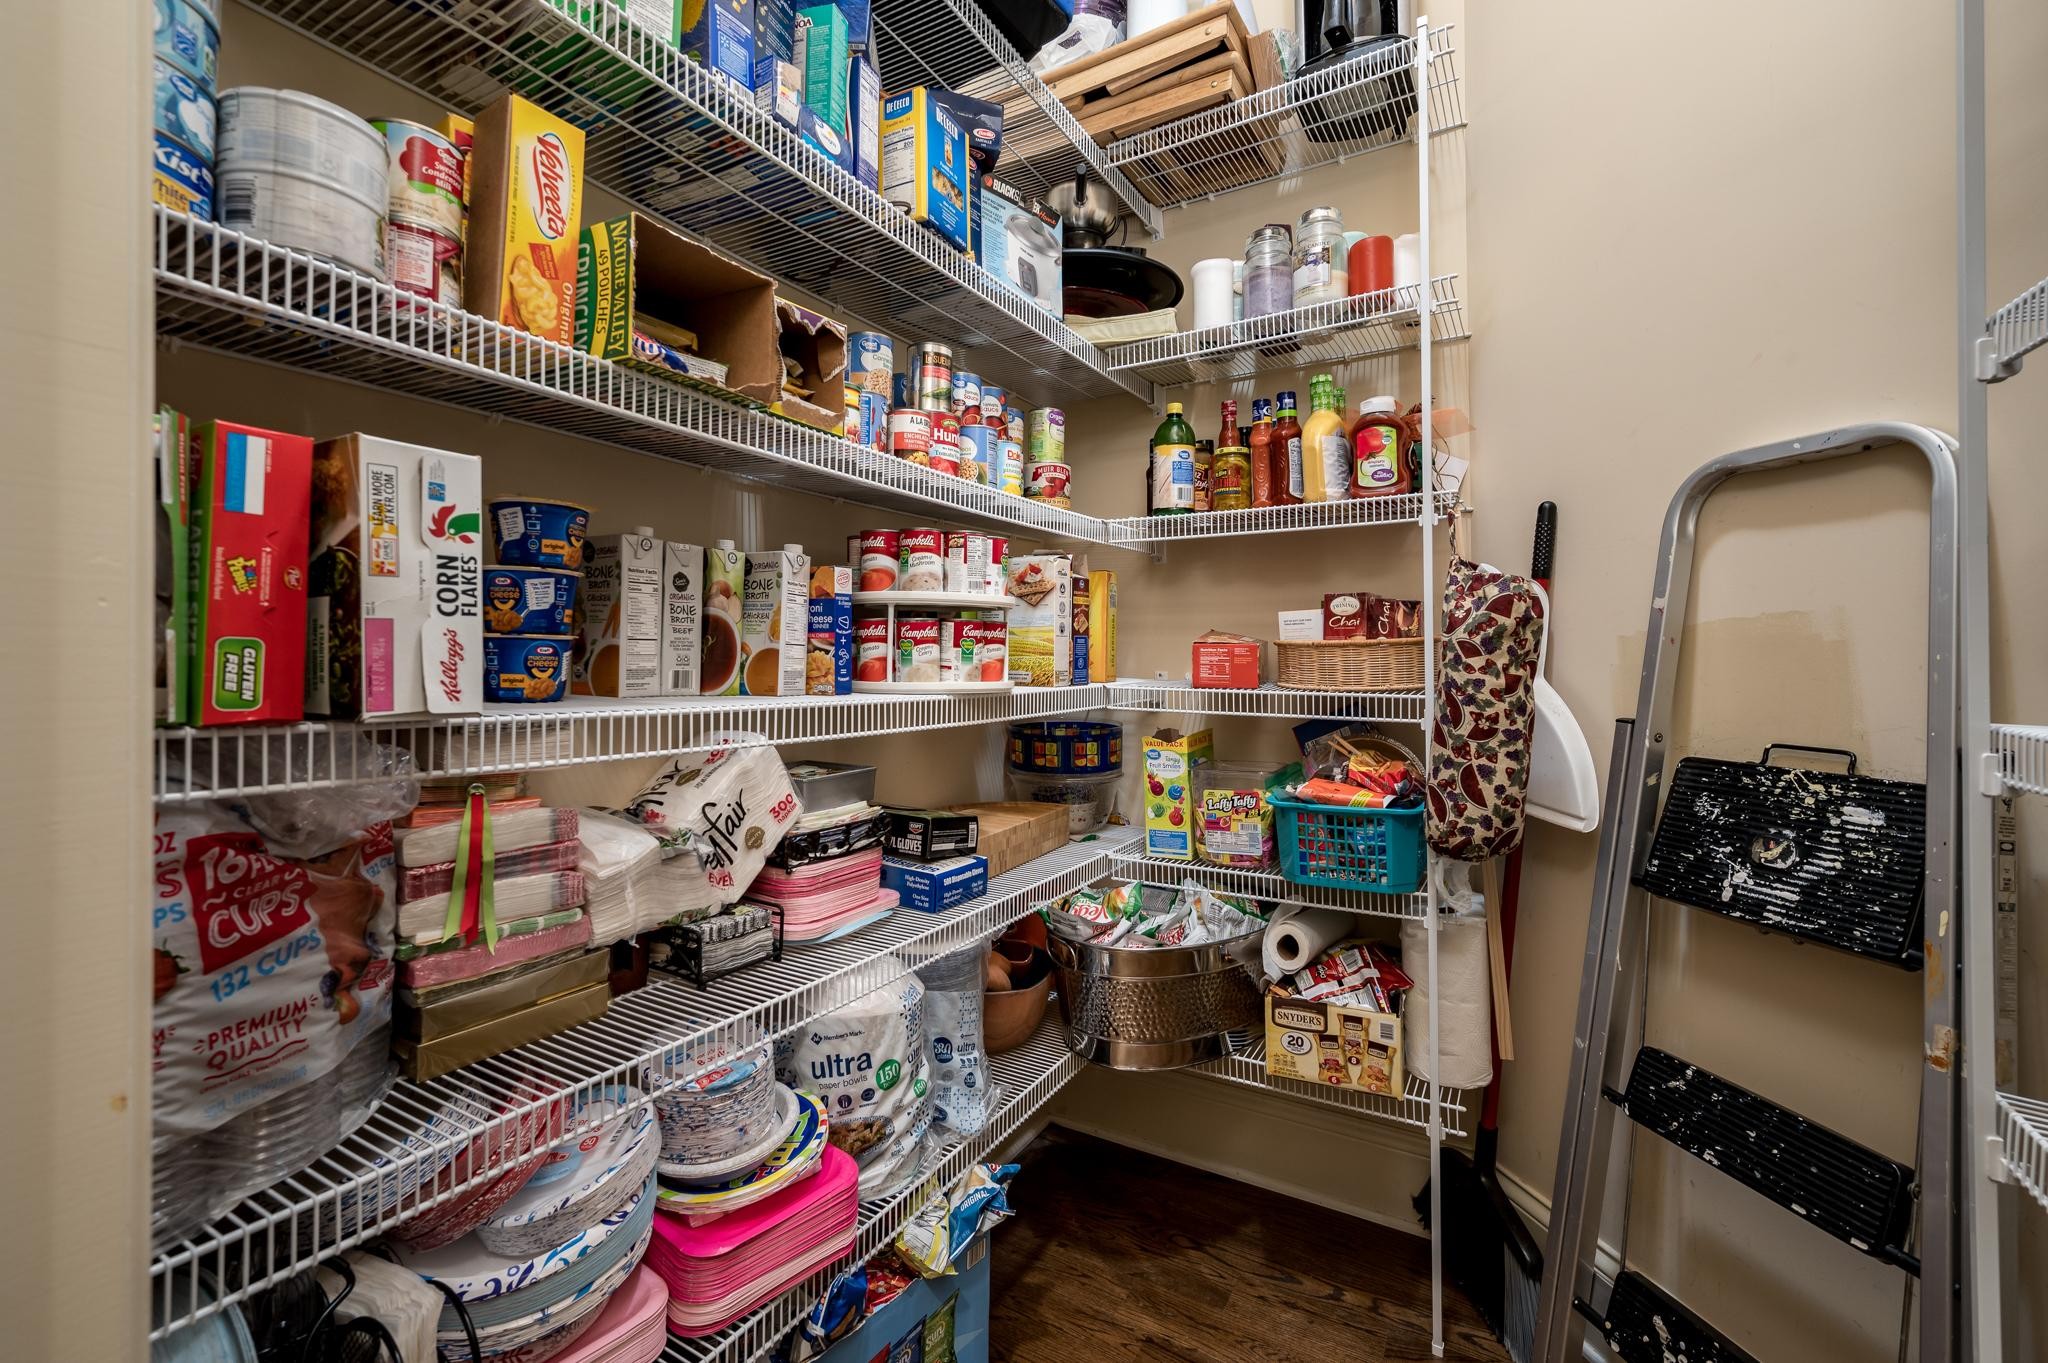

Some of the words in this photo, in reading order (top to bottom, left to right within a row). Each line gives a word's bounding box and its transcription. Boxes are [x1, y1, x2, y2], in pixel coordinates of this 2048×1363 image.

[537, 135, 567, 238] Velveeta
[599, 249, 608, 267] 49
[609, 219, 628, 287] NATURE
[595, 268, 611, 335] POUCHES
[607, 288, 627, 354] VALLEY
[371, 470, 384, 498] MORE
[371, 499, 384, 526] LEARN
[543, 542, 565, 551] original
[584, 566, 615, 579] BONE
[436, 554, 460, 617] CORN
[461, 555, 478, 617] FLAKES
[743, 578, 774, 591] BONE
[745, 591, 770, 600] BROTH
[668, 603, 698, 616] BONE
[670, 616, 695, 625] BROTH
[1378, 601, 1391, 635] Chai
[671, 626, 695, 635] BEEF
[1329, 616, 1361, 628] Chai
[223, 652, 239, 692] FREE
[241, 647, 257, 701] GLUTEN
[440, 627, 464, 703] Kellogg's
[502, 677, 524, 685] original
[1165, 756, 1181, 764] Tangy
[769, 793, 795, 820] 300
[1206, 797, 1232, 812] Laffy
[1232, 794, 1257, 809] Taffy
[897, 837, 922, 852] GLOVES
[233, 875, 280, 898] CLEAR
[904, 874, 930, 886] High-Density
[943, 877, 951, 886] 500
[951, 870, 972, 884] Disposable
[972, 867, 984, 877] Gloves
[208, 881, 304, 949] CUPS
[210, 965, 251, 1001] 132
[256, 928, 321, 977] CUPS
[208, 997, 308, 1051] PREMIUM
[1277, 1011, 1322, 1026] SNYDER'S
[206, 1014, 308, 1071] QUALITY
[957, 1041, 976, 1053] ultra
[1287, 1035, 1304, 1047] 20
[811, 1052, 873, 1080] ultra
[877, 1063, 900, 1084] 150
[818, 1079, 841, 1091] paper
[842, 1073, 868, 1088] bowls
[959, 1189, 991, 1212] ORIGINAL
